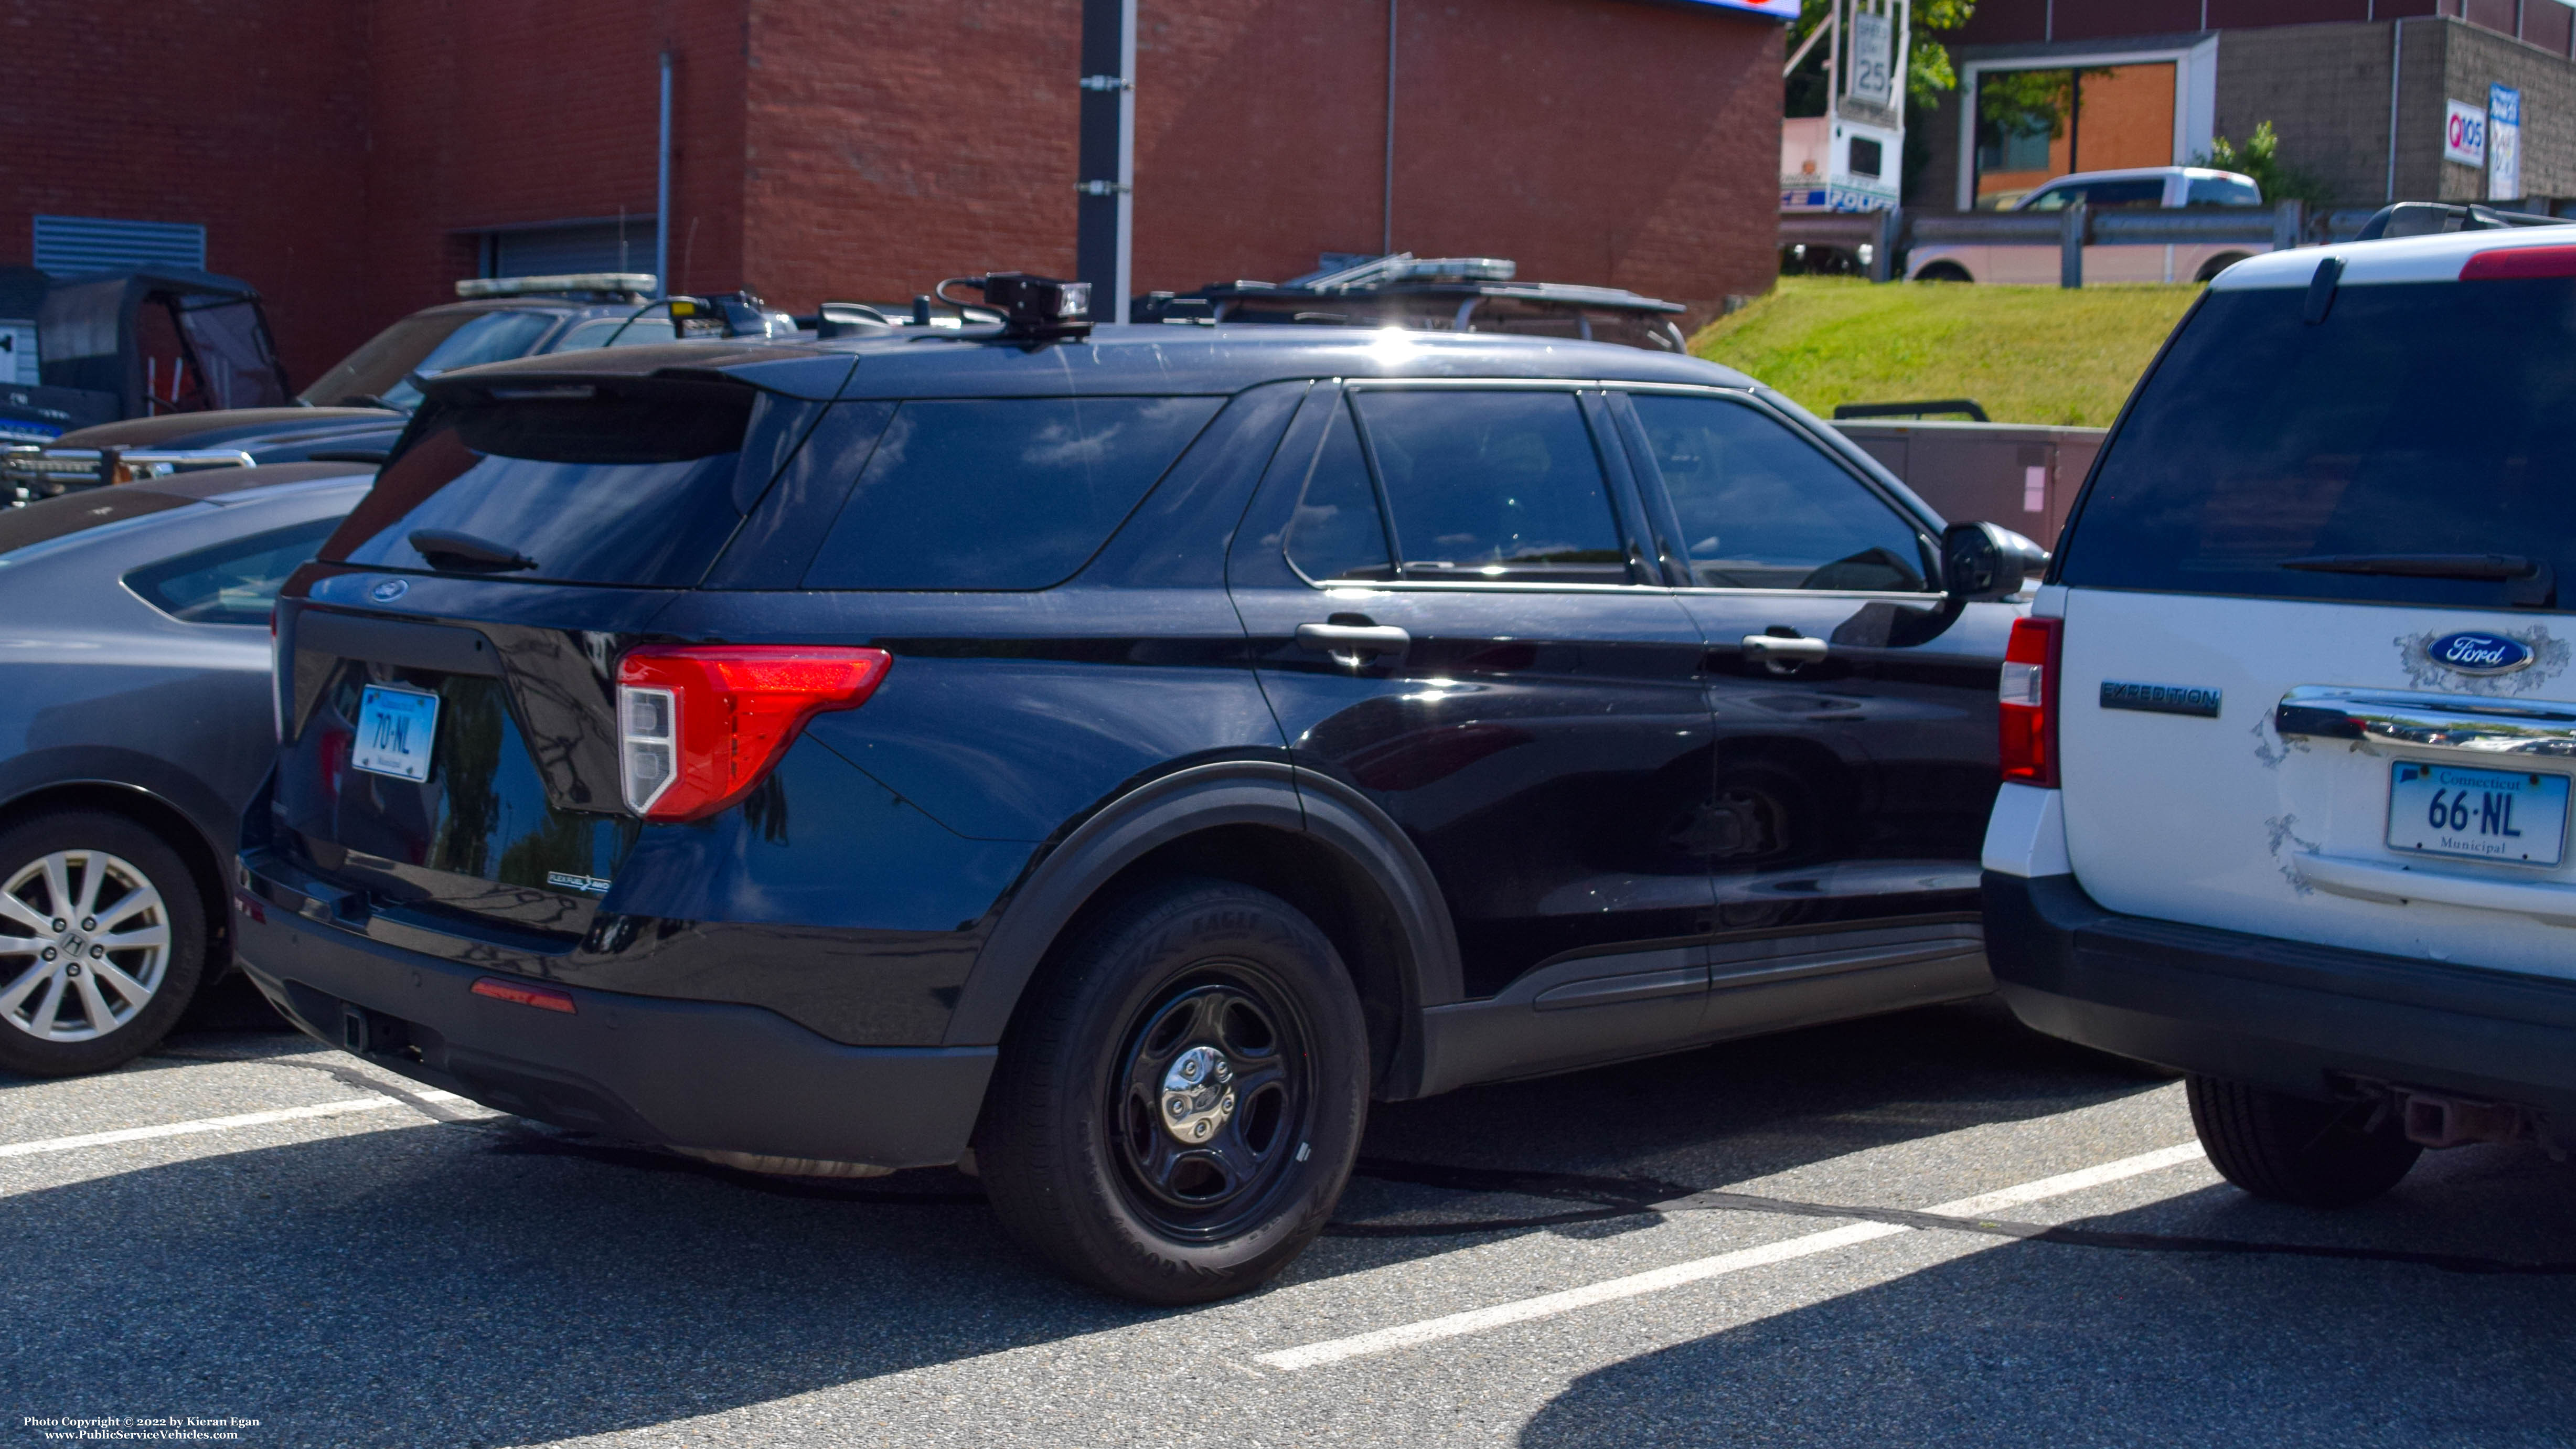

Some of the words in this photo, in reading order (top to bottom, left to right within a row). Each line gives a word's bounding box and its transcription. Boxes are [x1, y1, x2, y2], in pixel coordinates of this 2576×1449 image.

[1858, 59, 1886, 92] 25
[2449, 113, 2482, 148] Q105
[2445, 636, 2506, 664] Ford
[2103, 681, 2218, 705] EXPEDITION
[2439, 771, 2521, 791] Connecticut
[2440, 836, 2506, 855] Municipal
